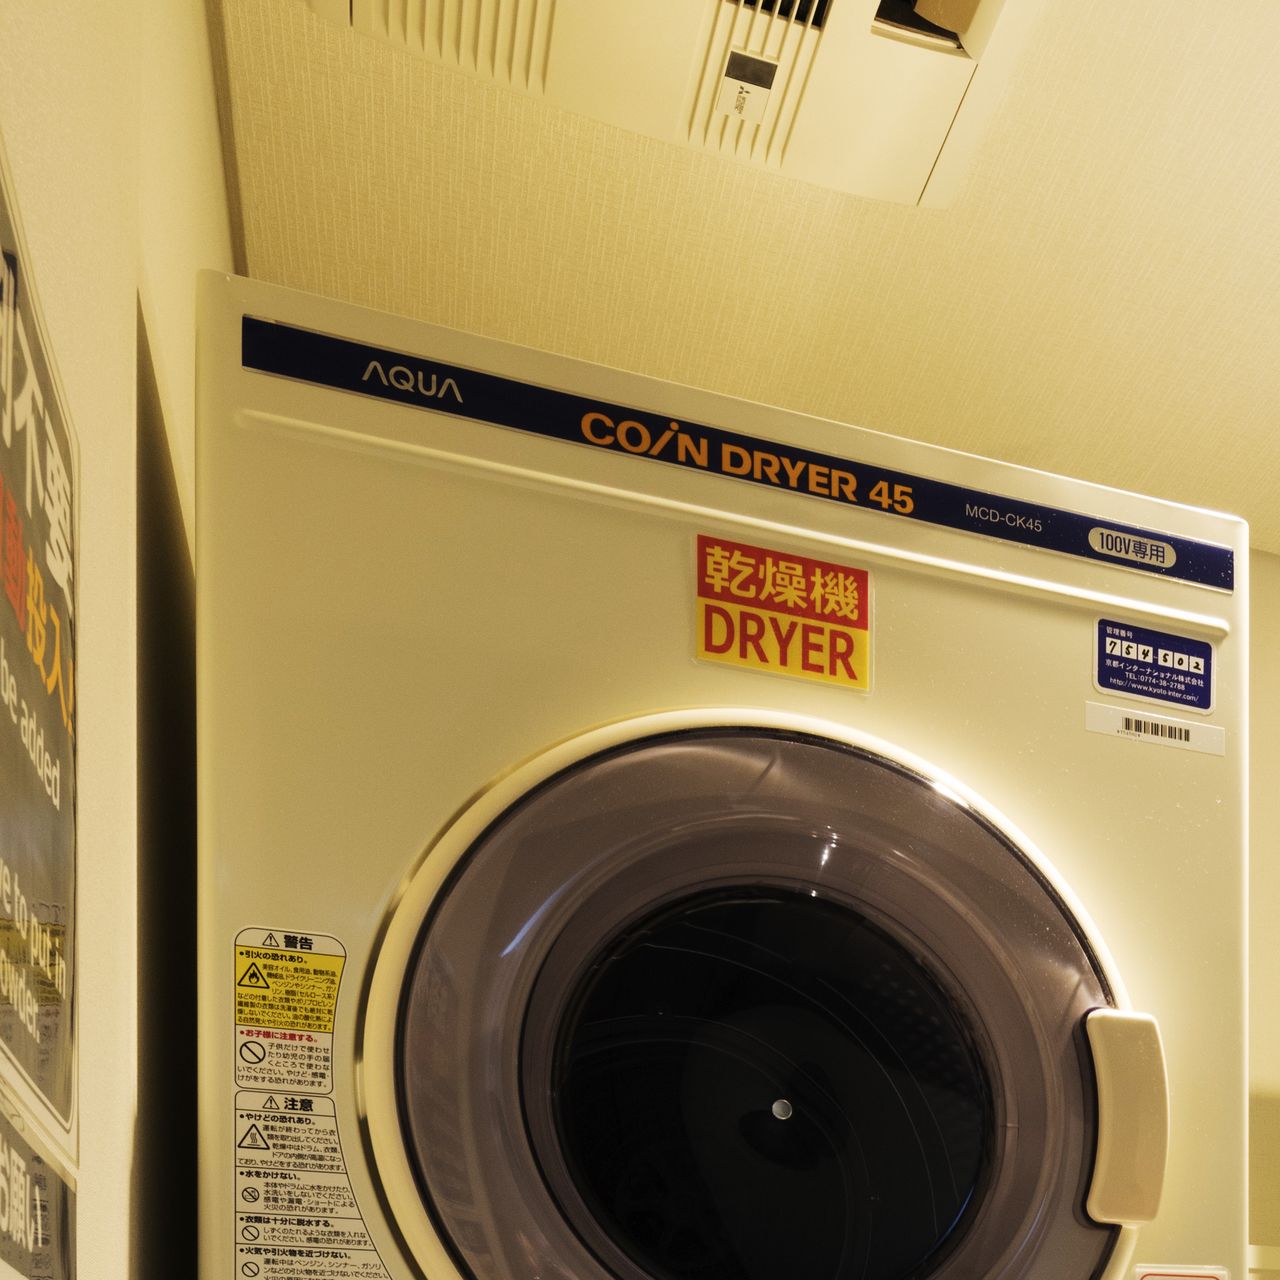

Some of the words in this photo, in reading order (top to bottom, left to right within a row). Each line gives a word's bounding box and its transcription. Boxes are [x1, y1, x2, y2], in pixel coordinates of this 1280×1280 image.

[362, 360, 463, 403] AQUA
[721, 443, 858, 501] DRYER
[869, 481, 914, 514] 45
[966, 504, 1042, 532] MCD-CK45
[1099, 532, 1166, 564] 100V専用
[704, 546, 859, 620] 乾燥機
[704, 606, 857, 680] DRYER
[1106, 627, 1133, 639] 管理番号
[1105, 659, 1204, 688] 京都インターナショナル株式会社
[21, 697, 60, 810] added
[14, 872, 28, 940] to
[31, 910, 53, 980] put
[55, 935, 66, 999] in
[283, 935, 313, 950] 警告
[245, 1030, 318, 1042] お子様に注意する。
[284, 1098, 313, 1111] 注意
[245, 1170, 301, 1180] 水をかけない。
